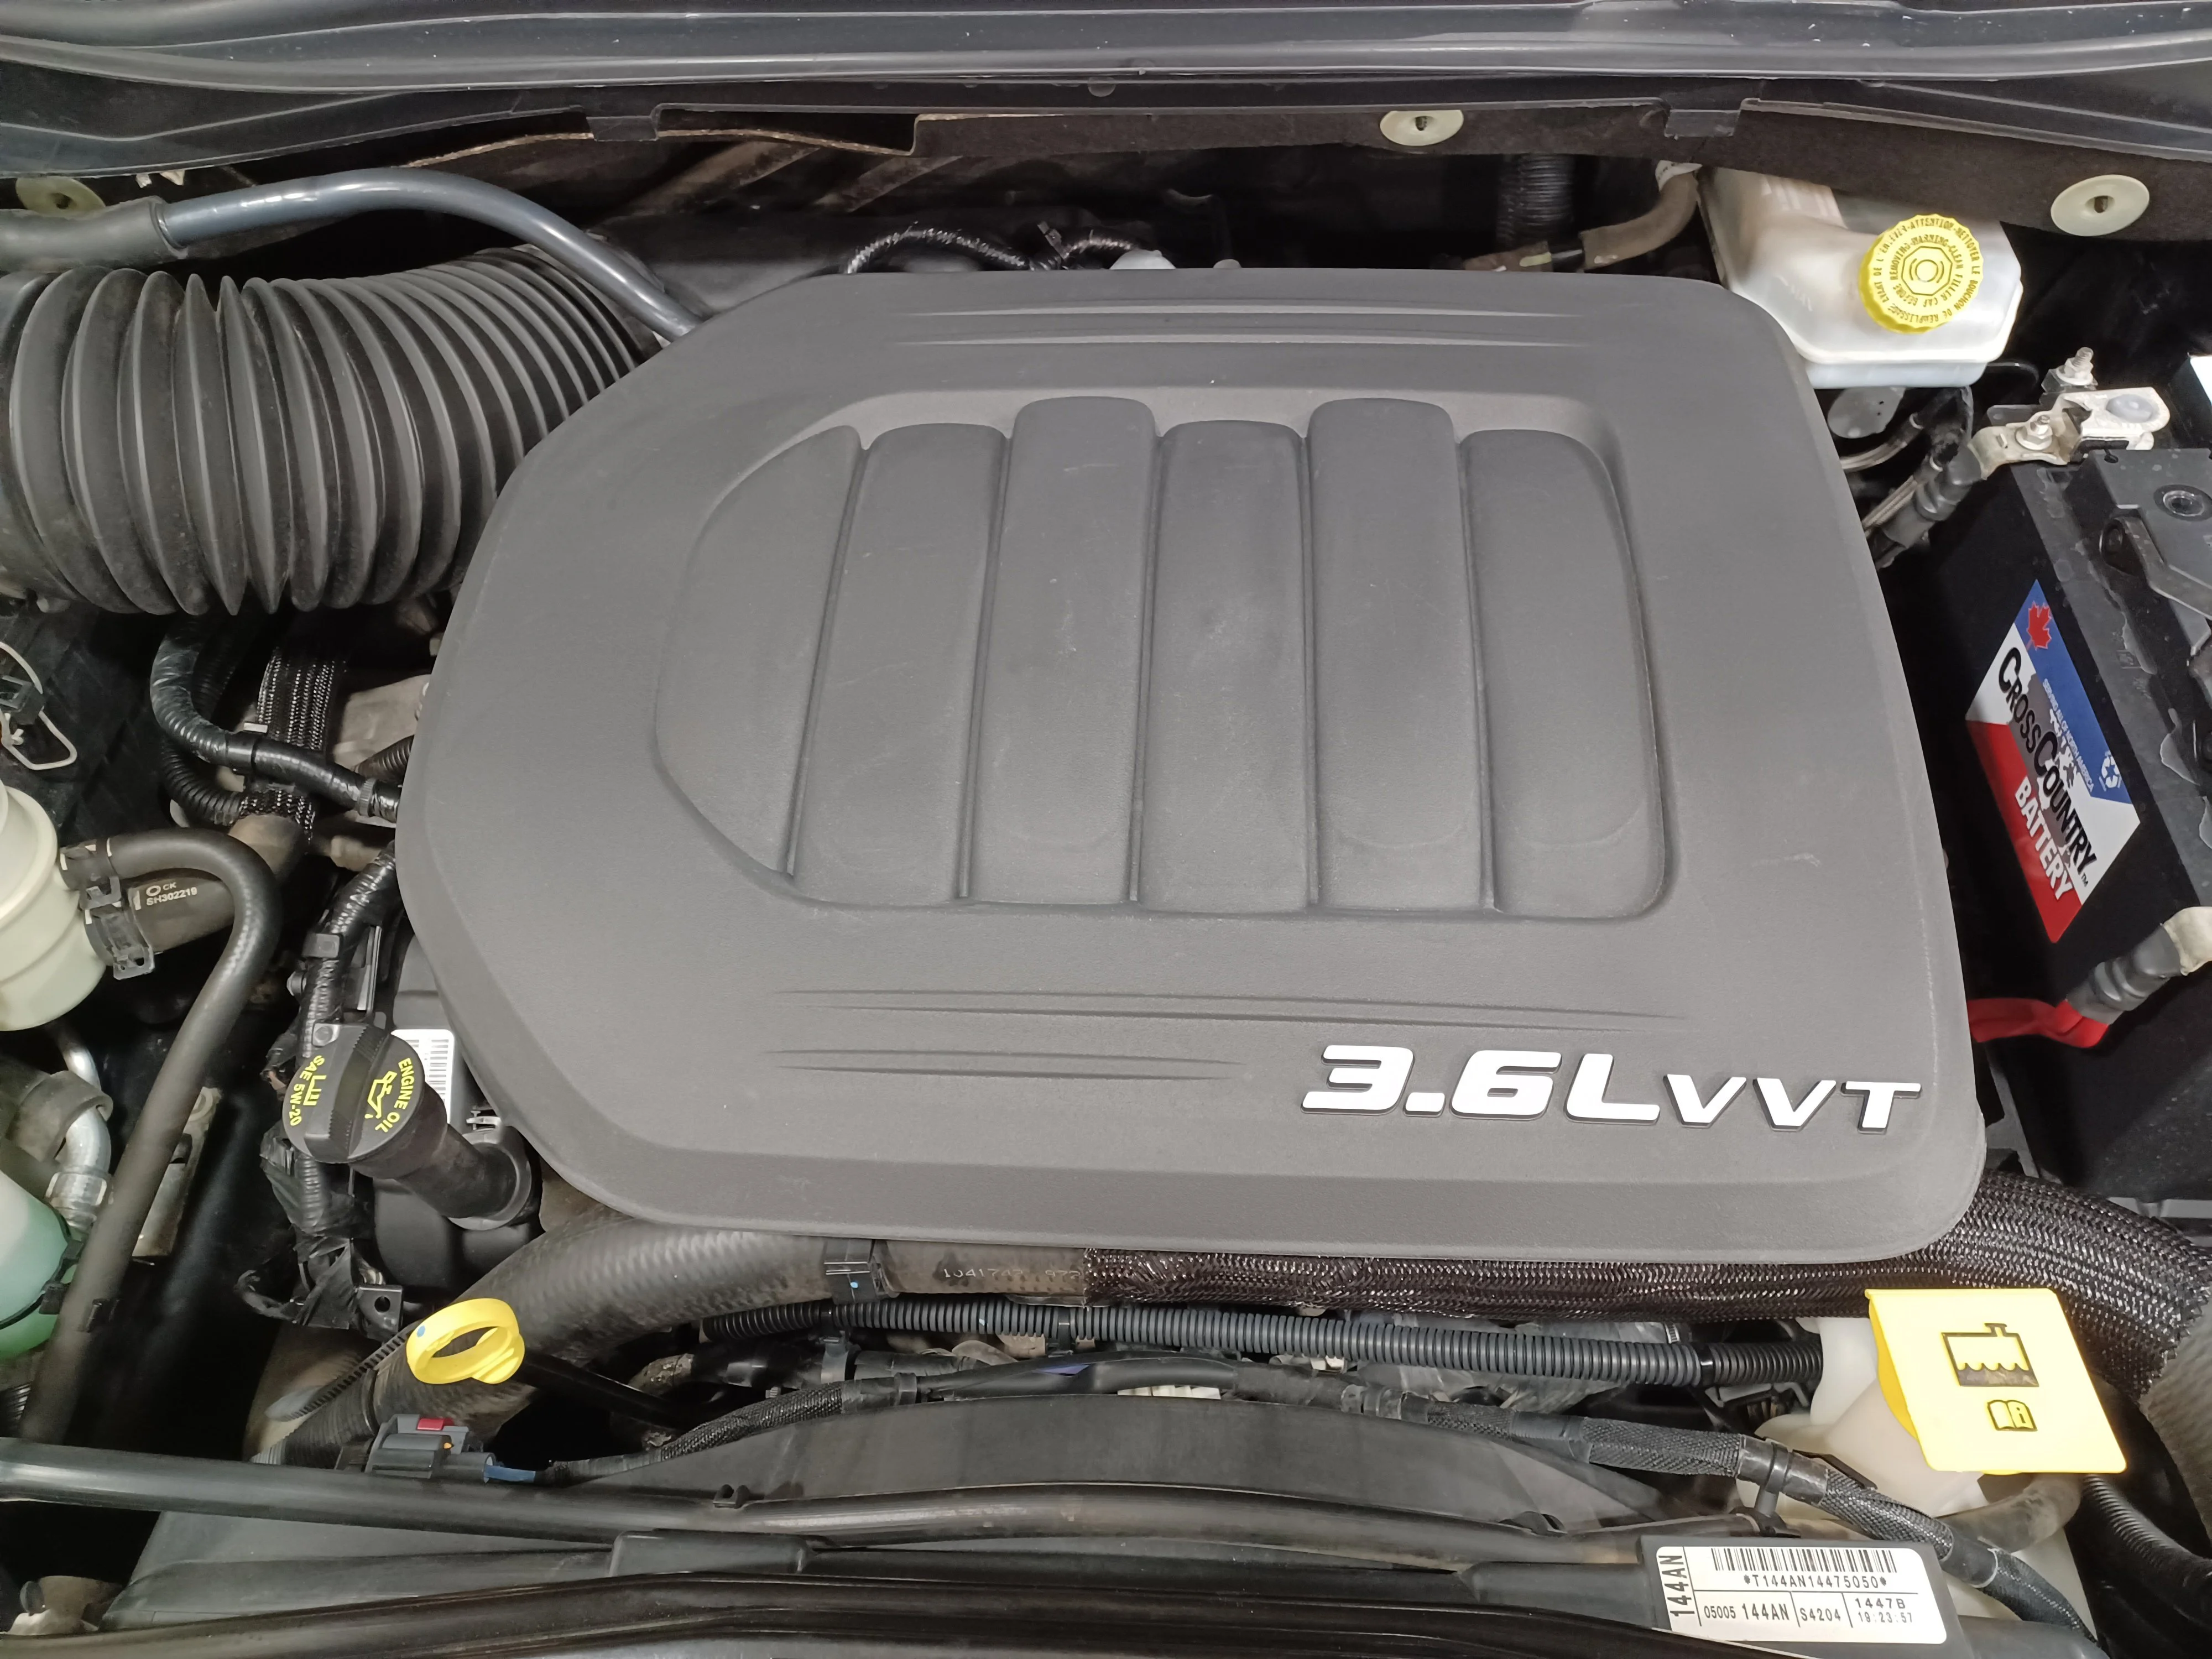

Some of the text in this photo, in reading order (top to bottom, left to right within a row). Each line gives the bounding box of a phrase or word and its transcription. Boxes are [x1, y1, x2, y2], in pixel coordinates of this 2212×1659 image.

[1873, 267, 1882, 276] DE
[1971, 266, 1980, 274] LE
[1940, 274, 1963, 301] FILLER
[1954, 280, 1978, 310] BOUCHON
[1943, 309, 1953, 319] DE
[2015, 775, 2074, 900] BATTERY
[289, 1055, 325, 1126] SAE 5W-20
[374, 1057, 415, 1133] ENGINE OIL
[1301, 1045, 1922, 1134] 3.6L VVT
[1658, 1554, 1695, 1618] 144AN
[1704, 1603, 1790, 1621] 05005 144AN
[1799, 1607, 1841, 1621] S4204
[1855, 1598, 1906, 1609] 1447B
